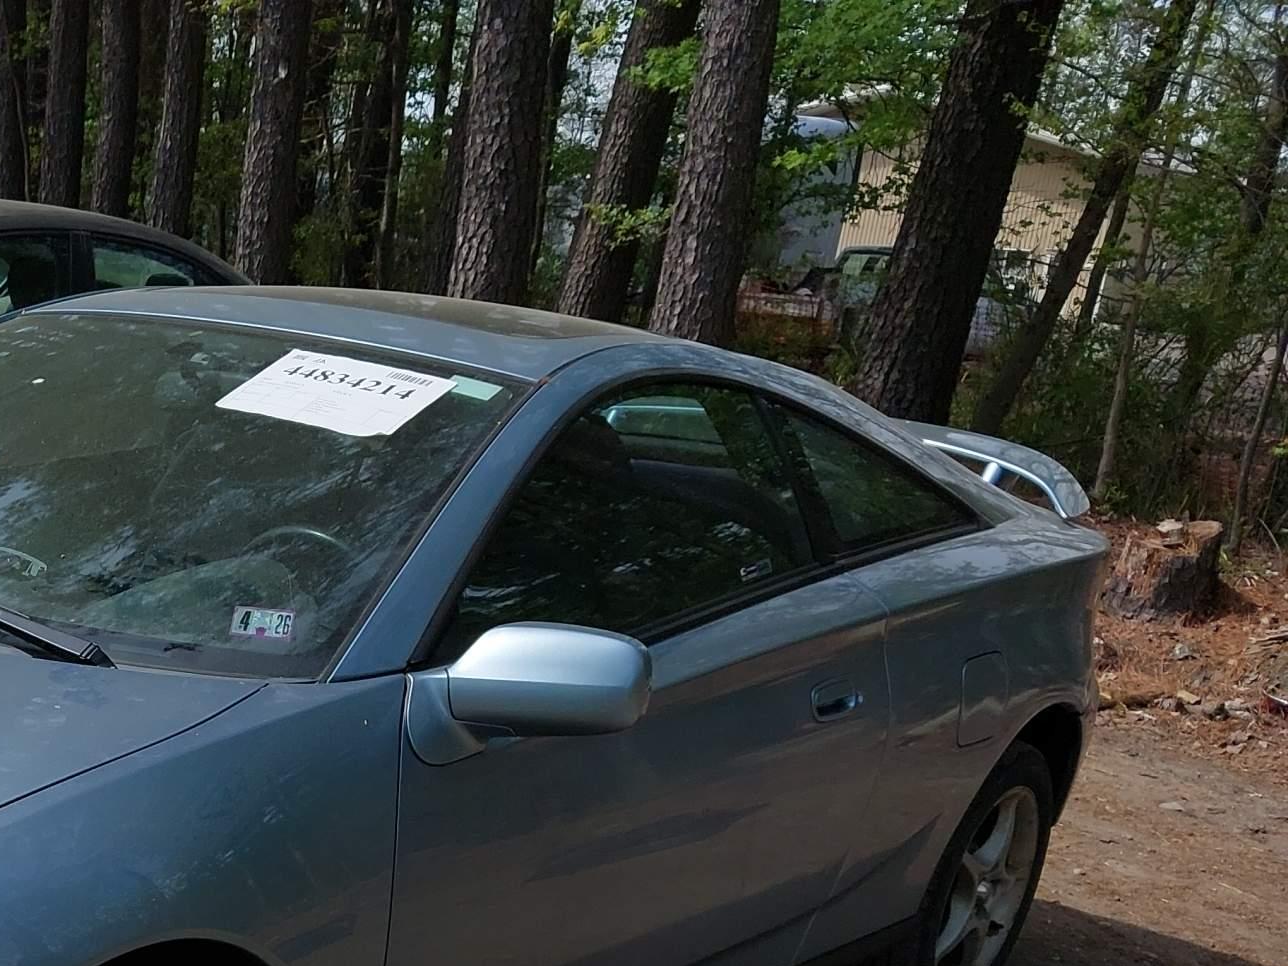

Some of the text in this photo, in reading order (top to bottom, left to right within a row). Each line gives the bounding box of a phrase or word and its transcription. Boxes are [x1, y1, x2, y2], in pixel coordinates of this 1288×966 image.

[283, 365, 417, 399] 44834214
[239, 611, 292, 635] 4 26
